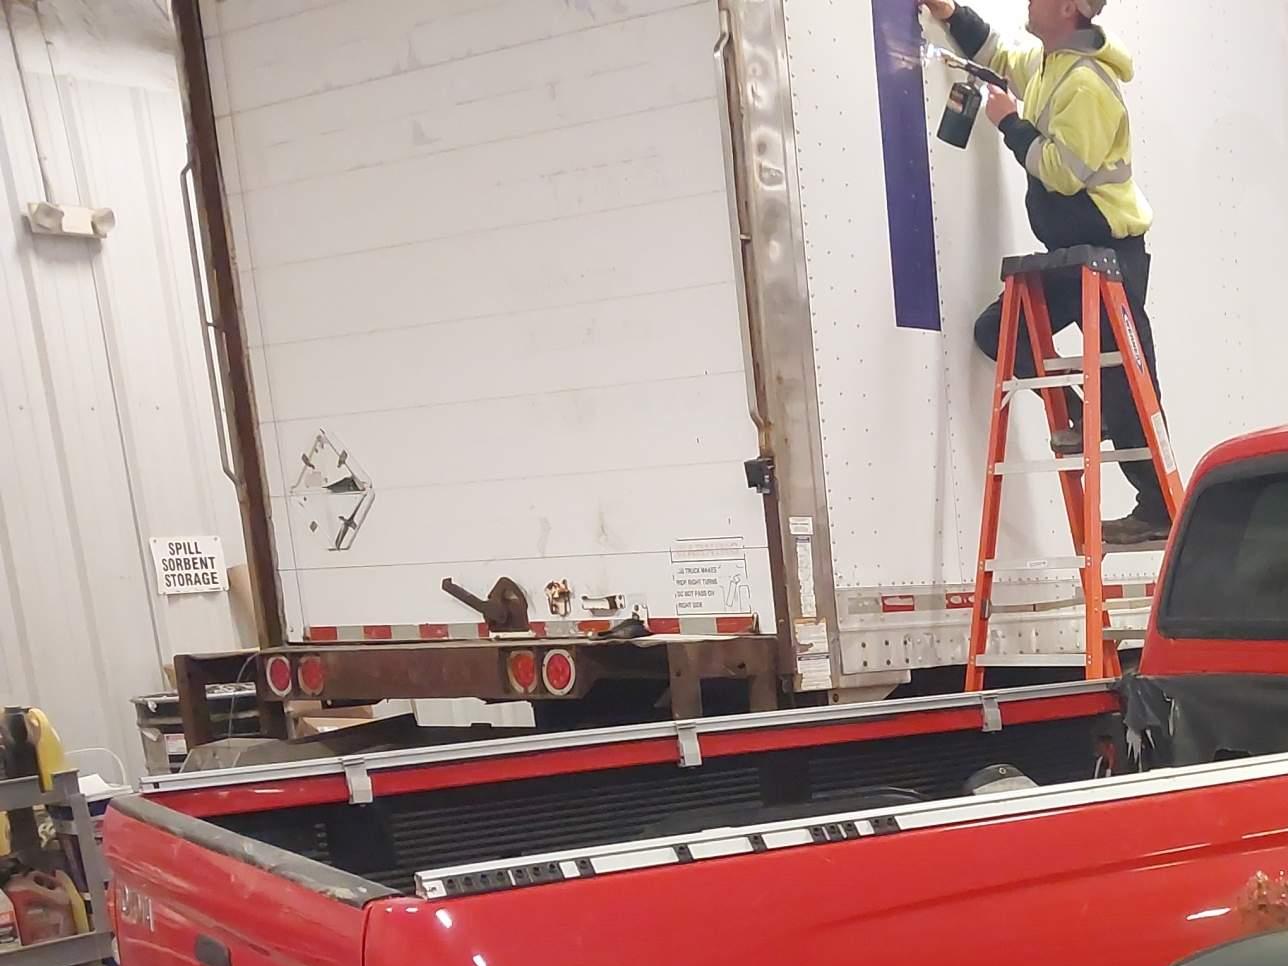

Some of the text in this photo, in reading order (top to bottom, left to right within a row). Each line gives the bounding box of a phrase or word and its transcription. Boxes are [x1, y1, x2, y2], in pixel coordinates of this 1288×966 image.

[168, 541, 202, 556] SPILL
[161, 556, 216, 572] SORBENT
[164, 571, 219, 587] STORAGE
